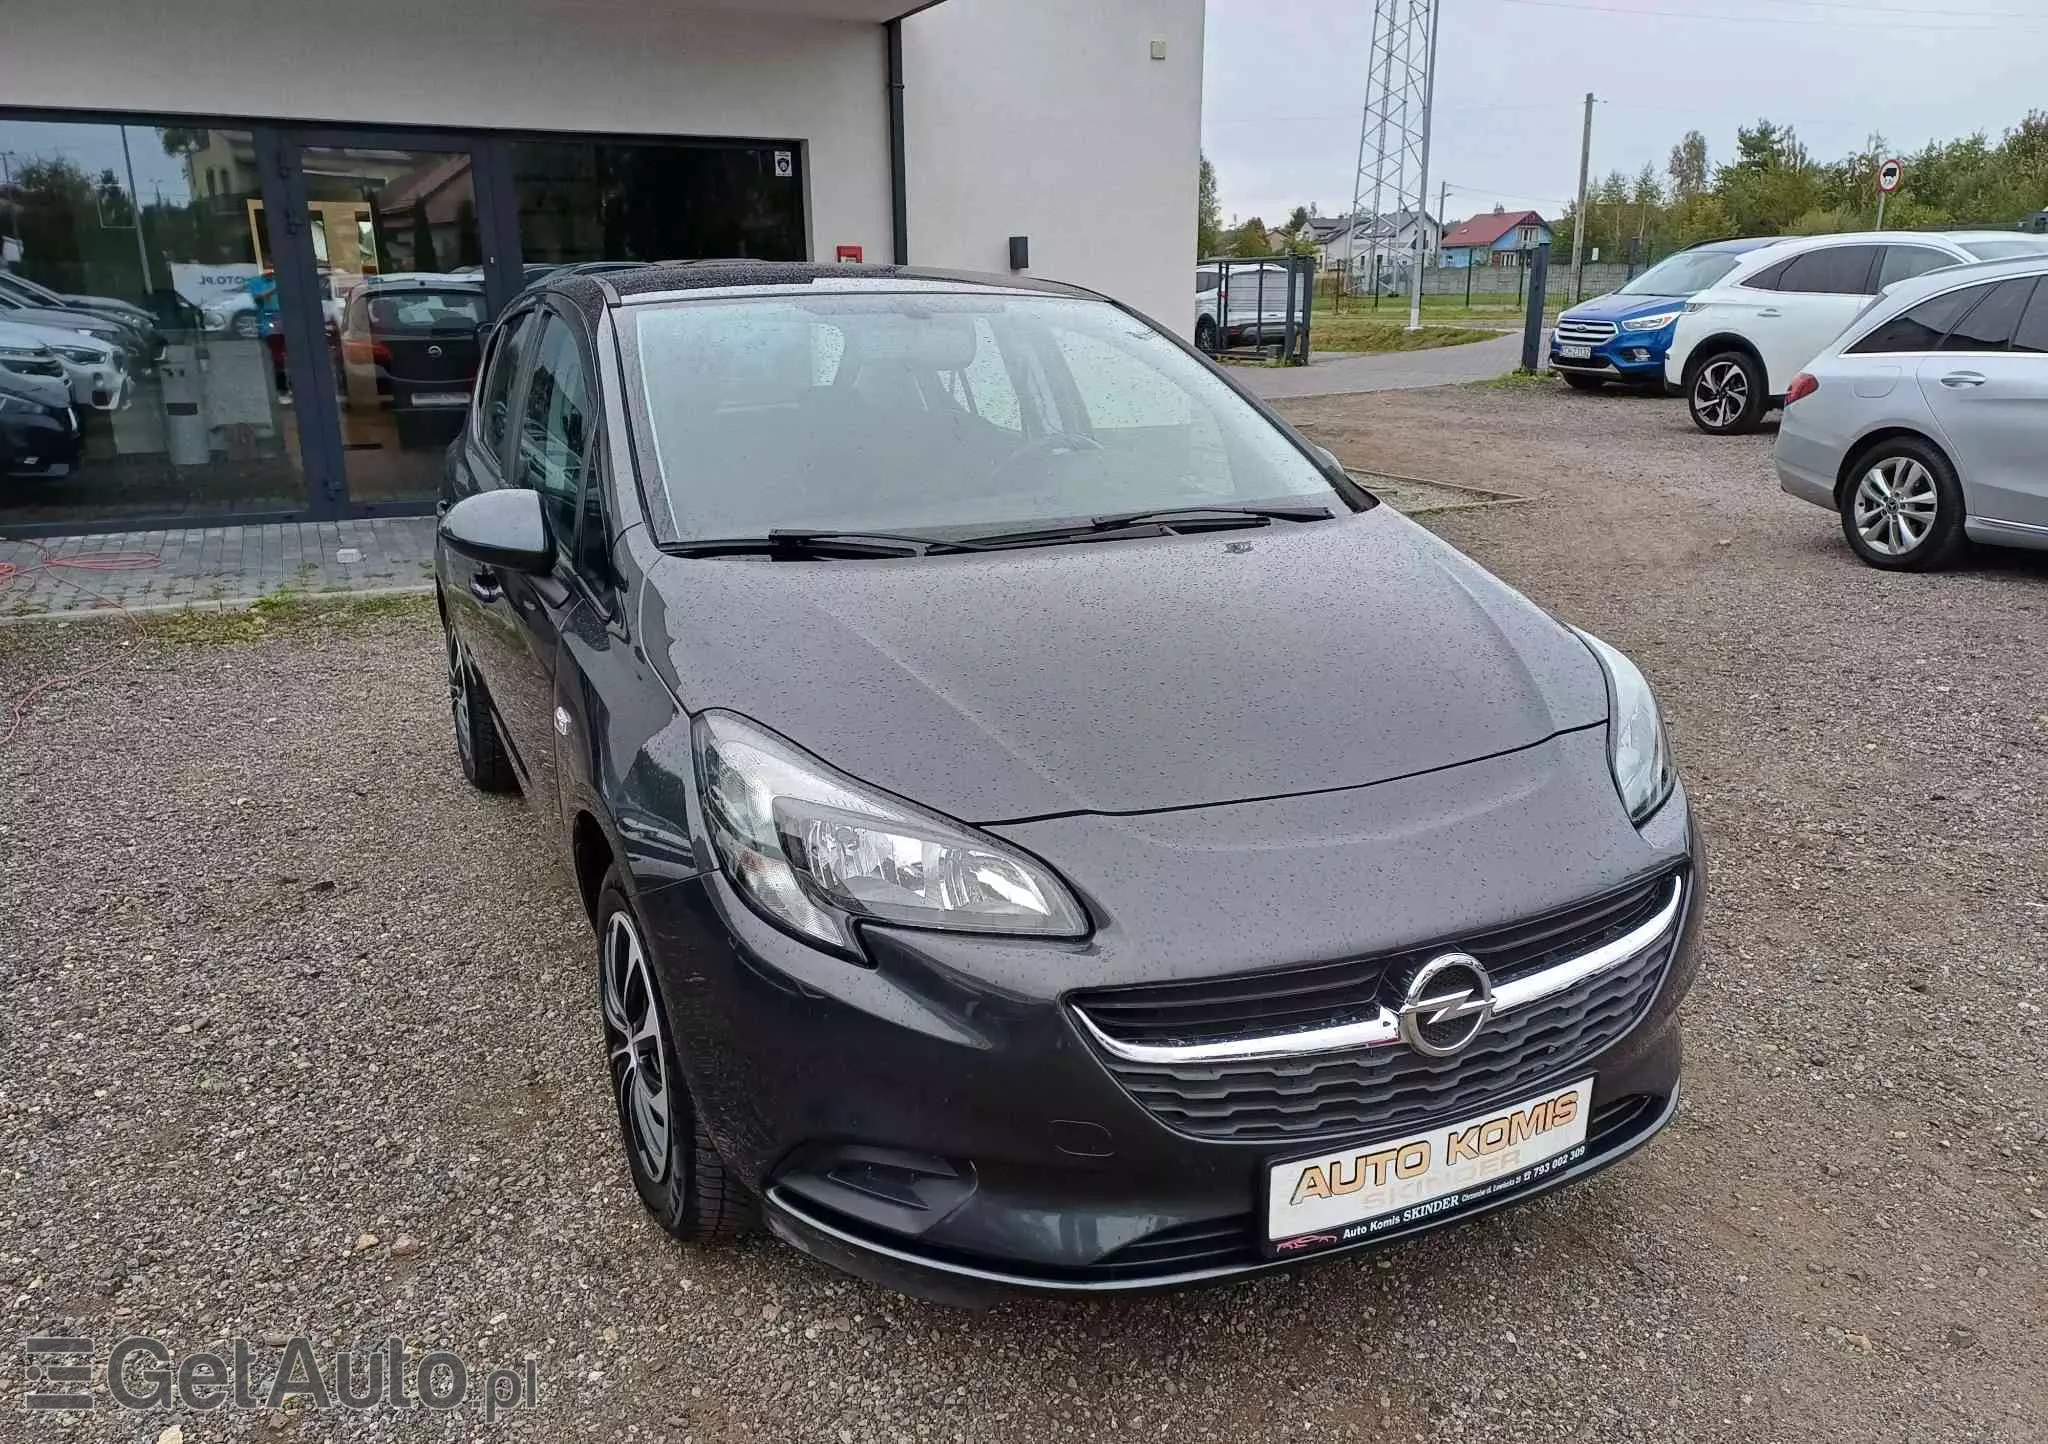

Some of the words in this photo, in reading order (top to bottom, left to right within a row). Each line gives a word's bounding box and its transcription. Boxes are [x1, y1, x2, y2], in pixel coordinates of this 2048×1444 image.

[1290, 1140, 1431, 1206] AUTO
[1447, 1091, 1579, 1166] KOMIS
[1343, 1226, 1367, 1239] Auto
[1370, 1216, 1400, 1232] Komis
[1403, 1195, 1460, 1222] SKINDER
[1533, 1163, 1550, 1177] 793
[1552, 1153, 1568, 1169] 002
[1570, 1146, 1586, 1160] 309
